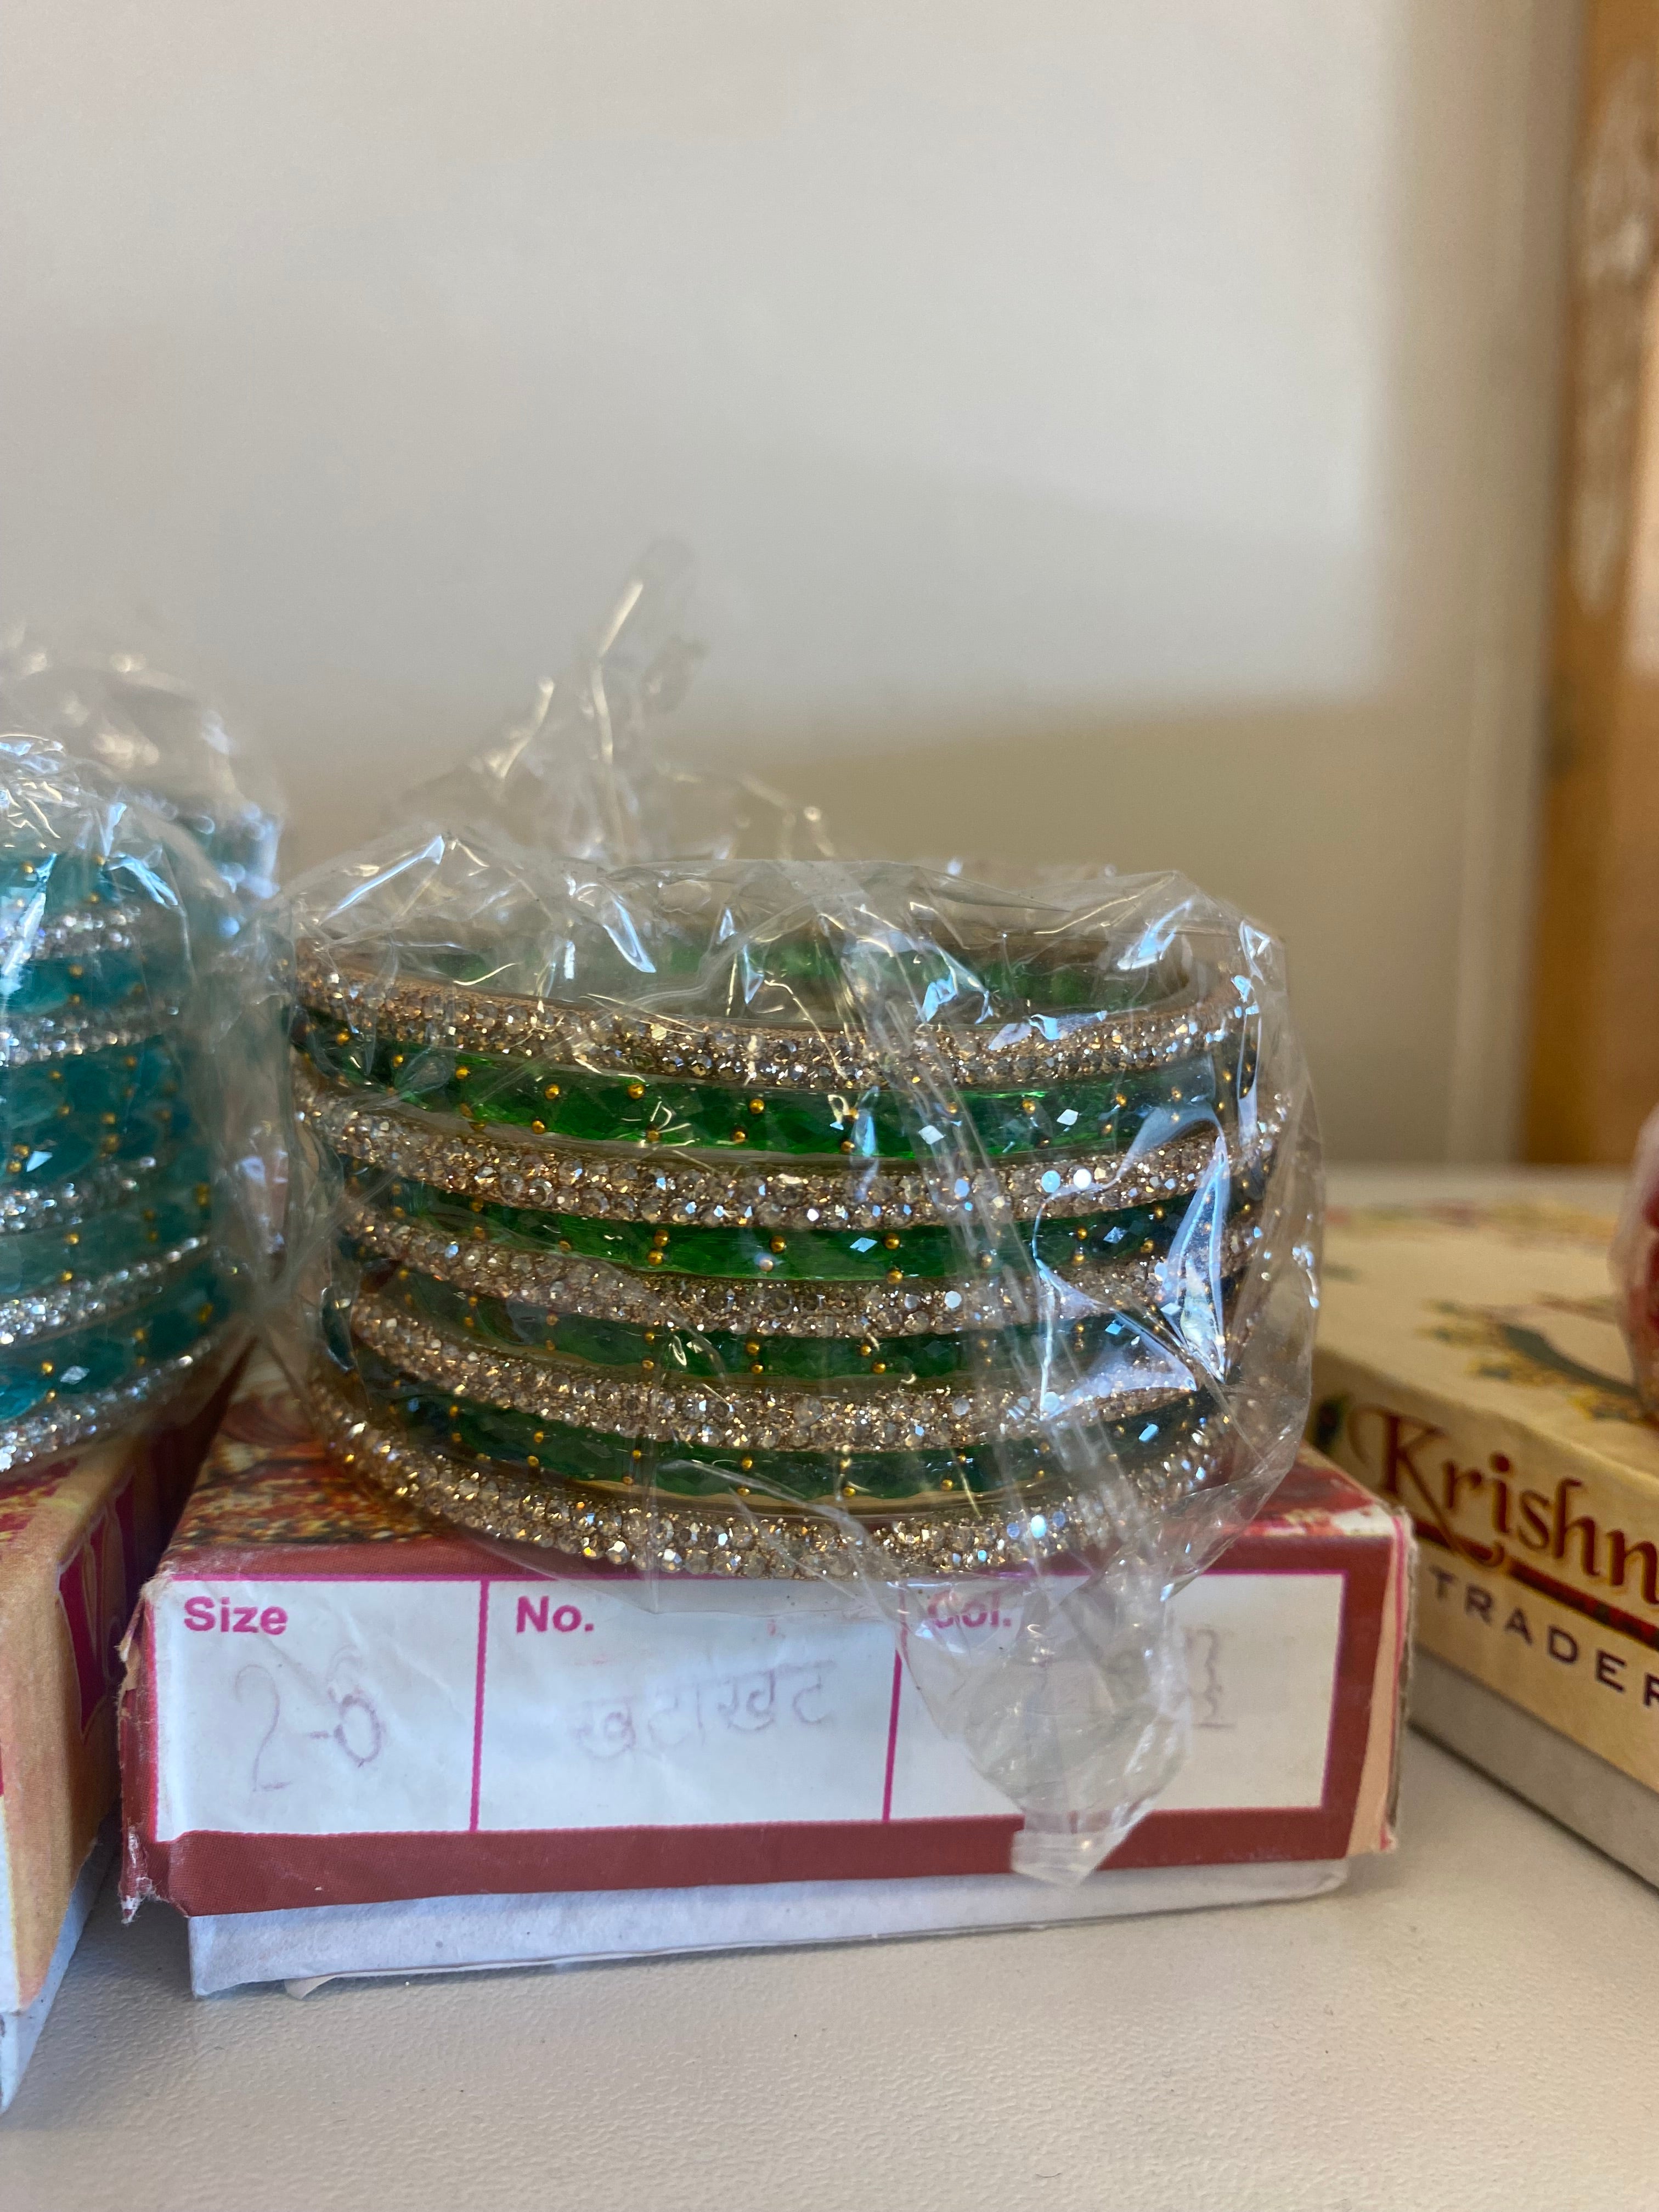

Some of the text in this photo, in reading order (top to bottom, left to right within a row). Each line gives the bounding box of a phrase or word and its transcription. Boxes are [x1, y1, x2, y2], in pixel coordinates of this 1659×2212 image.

[1347, 1403, 1659, 1605] Krishn
[183, 1596, 288, 1635] Size
[516, 1595, 594, 1634] No.
[927, 1589, 1012, 1629] Col.
